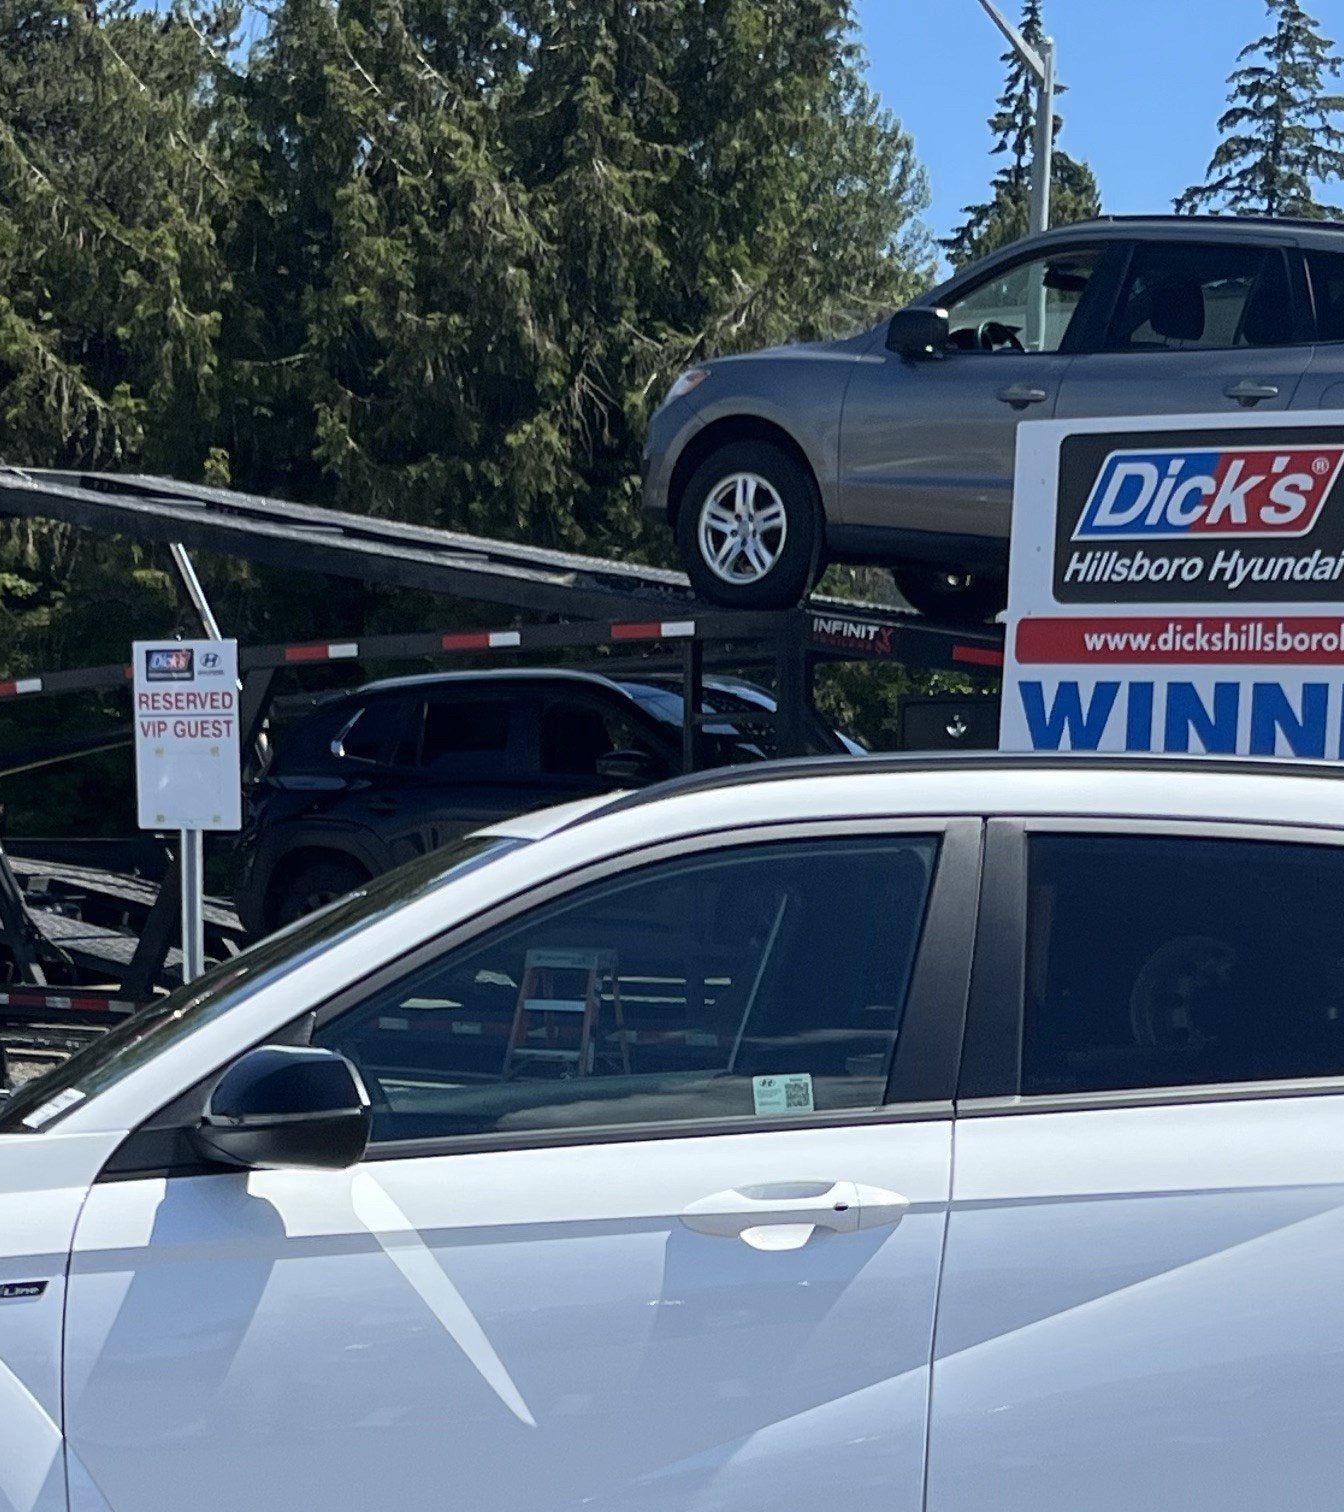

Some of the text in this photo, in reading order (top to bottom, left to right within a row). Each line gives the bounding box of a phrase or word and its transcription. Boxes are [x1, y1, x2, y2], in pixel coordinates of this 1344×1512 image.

[1063, 550, 1205, 583] Hillsboro
[137, 691, 234, 711] RESERVED
[140, 719, 234, 739] VIP GUEST
